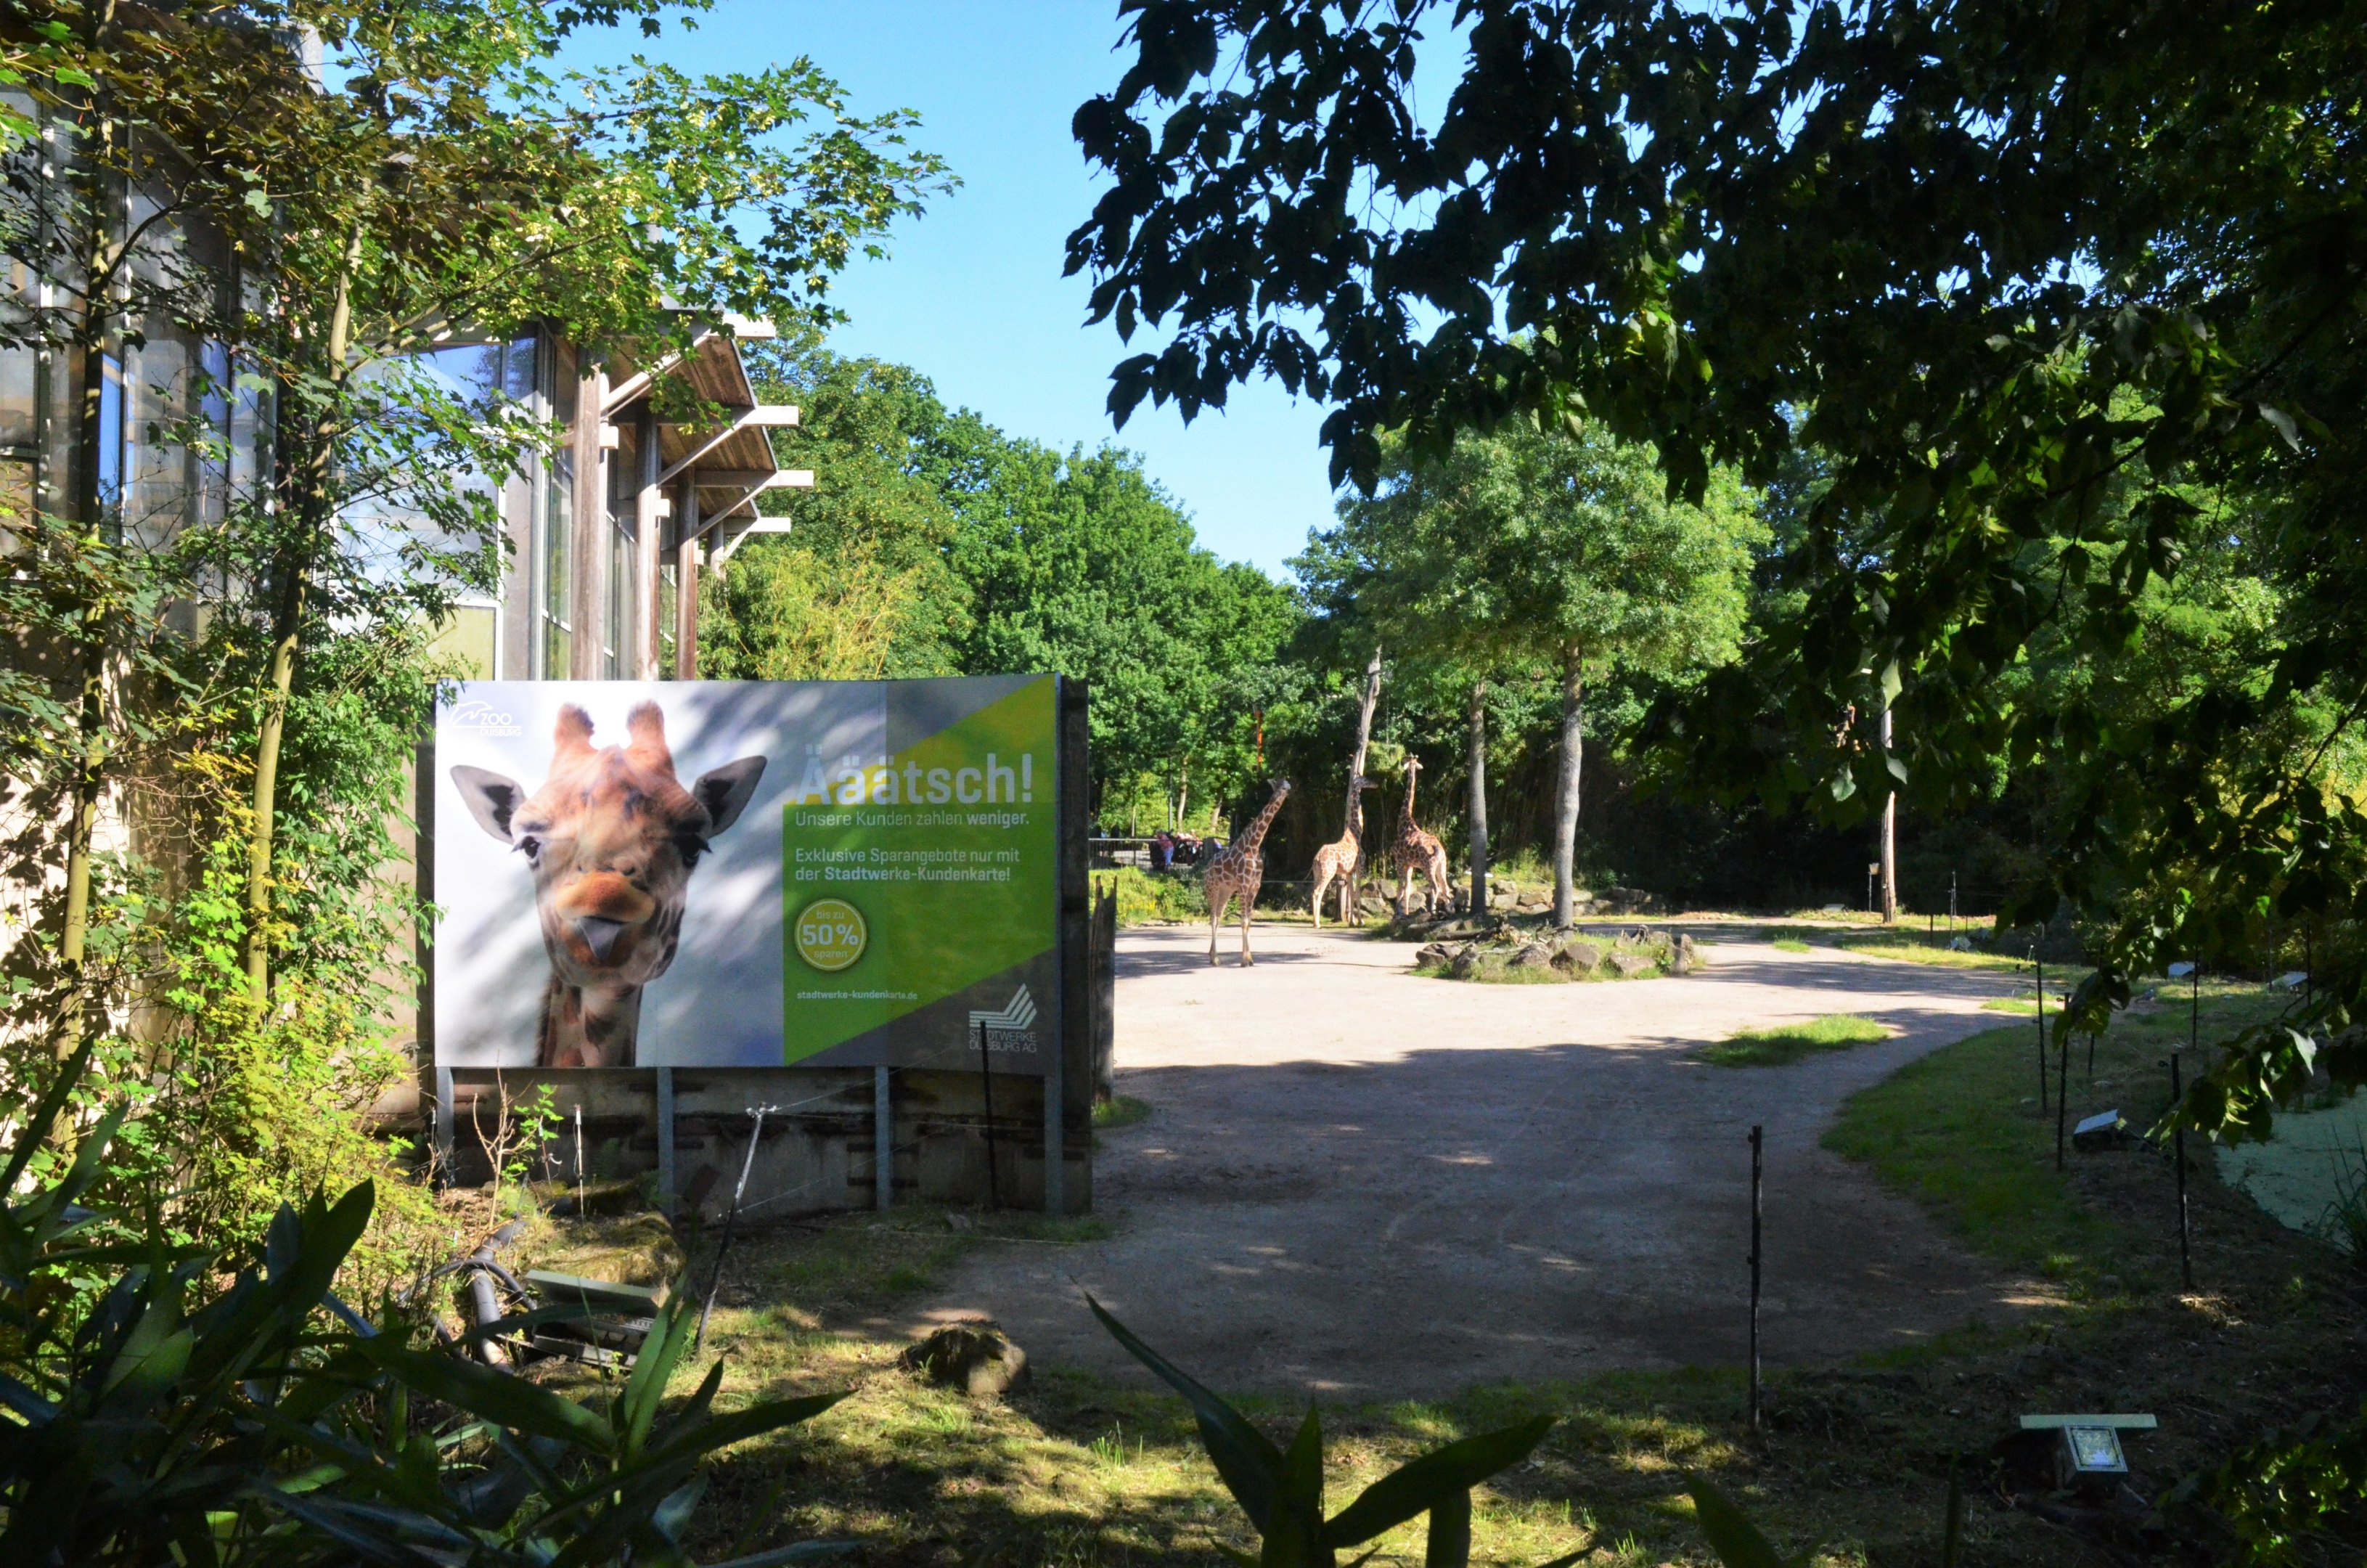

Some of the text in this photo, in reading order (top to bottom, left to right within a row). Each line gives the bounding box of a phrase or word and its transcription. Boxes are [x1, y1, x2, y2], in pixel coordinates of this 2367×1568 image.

[480, 713, 512, 725] ZOO
[480, 728, 523, 737] DUISBURG
[797, 743, 1032, 806] Ääätsch!
[796, 809, 1029, 829] Unsere Kunden zahlen weniger.
[796, 848, 1020, 865] Exklusive Sparangebote nur mit
[796, 866, 1010, 881] der Stadtwerke-Kundenkarte!
[817, 910, 830, 919] bis
[814, 950, 848, 960] sparen
[797, 990, 918, 1000] stadtwerke-kundenkarte.de
[969, 1029, 1037, 1042] STDTWERKE
[969, 1040, 1037, 1053] DUSBURG AG
